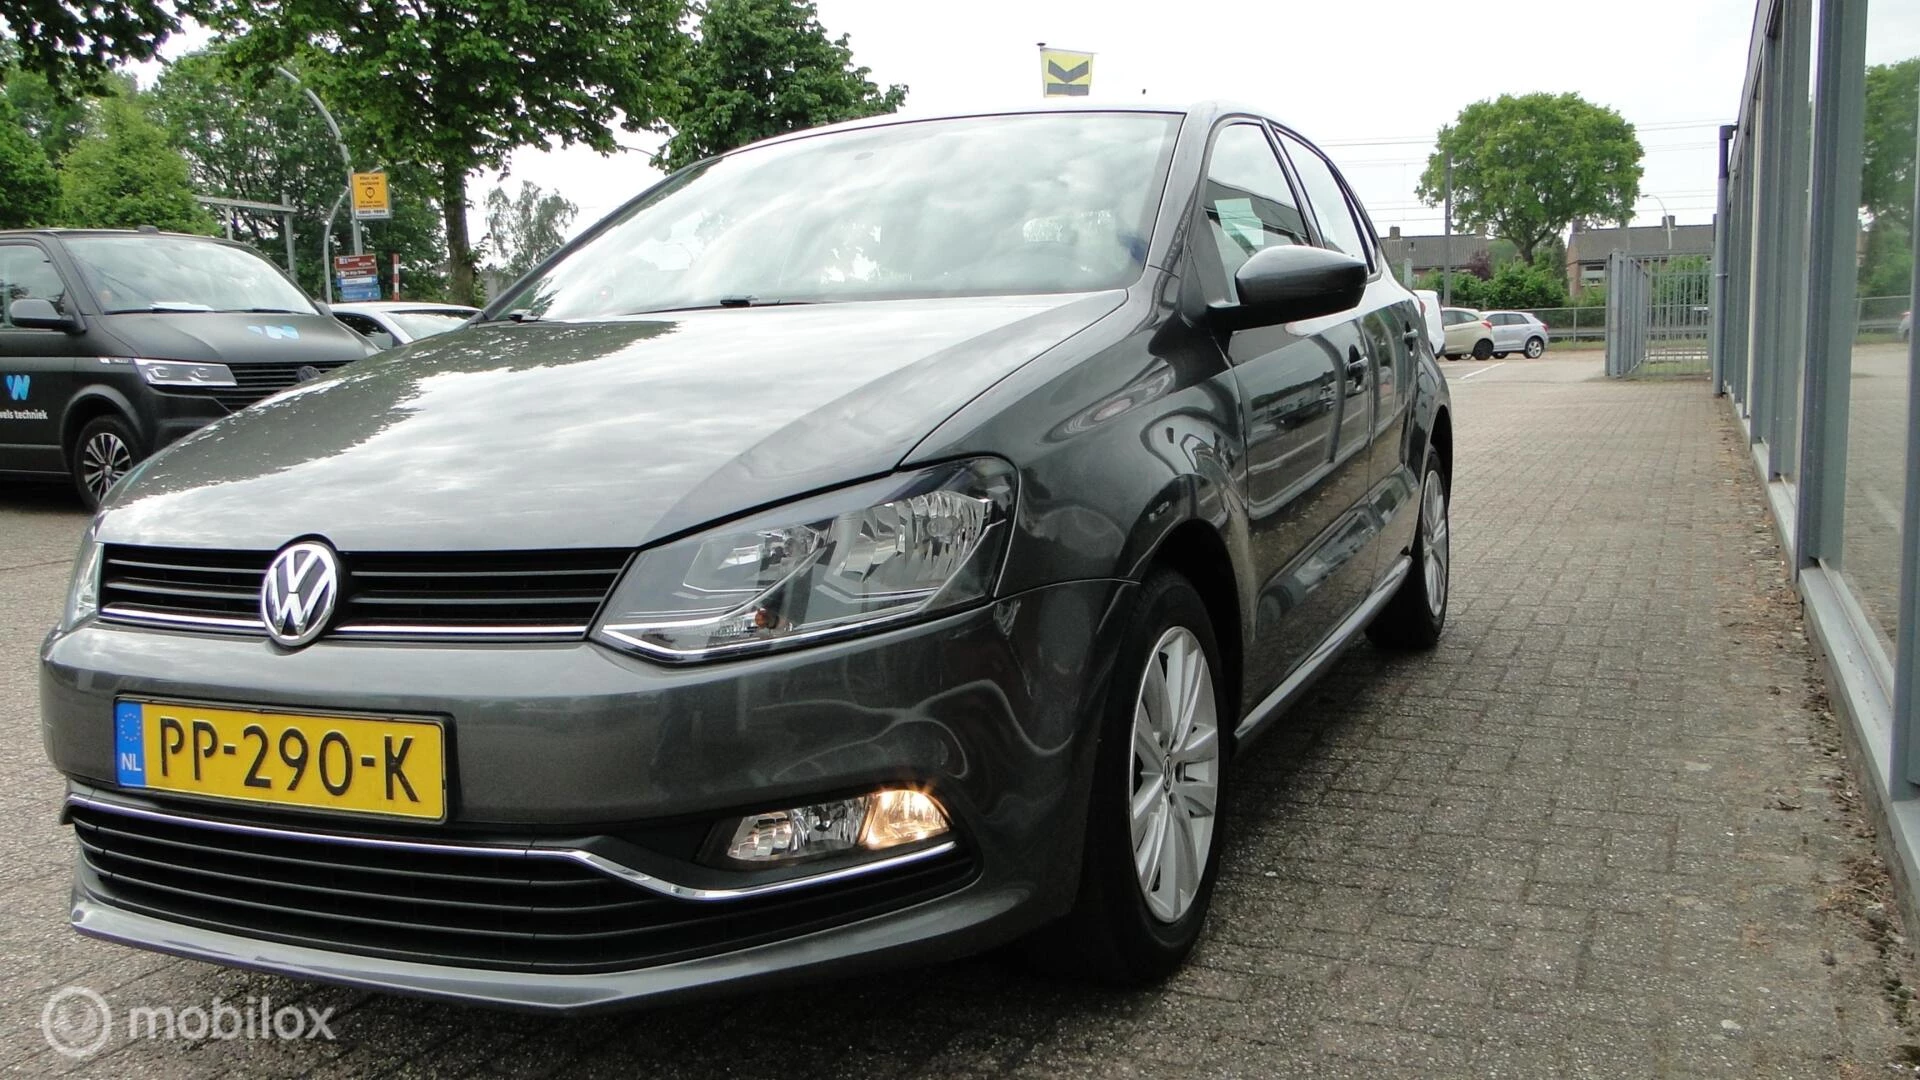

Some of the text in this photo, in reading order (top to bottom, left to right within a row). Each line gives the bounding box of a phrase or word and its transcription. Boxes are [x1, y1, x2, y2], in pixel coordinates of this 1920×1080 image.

[14, 409, 48, 420] techniek
[122, 717, 420, 802] NL PP-290-K
